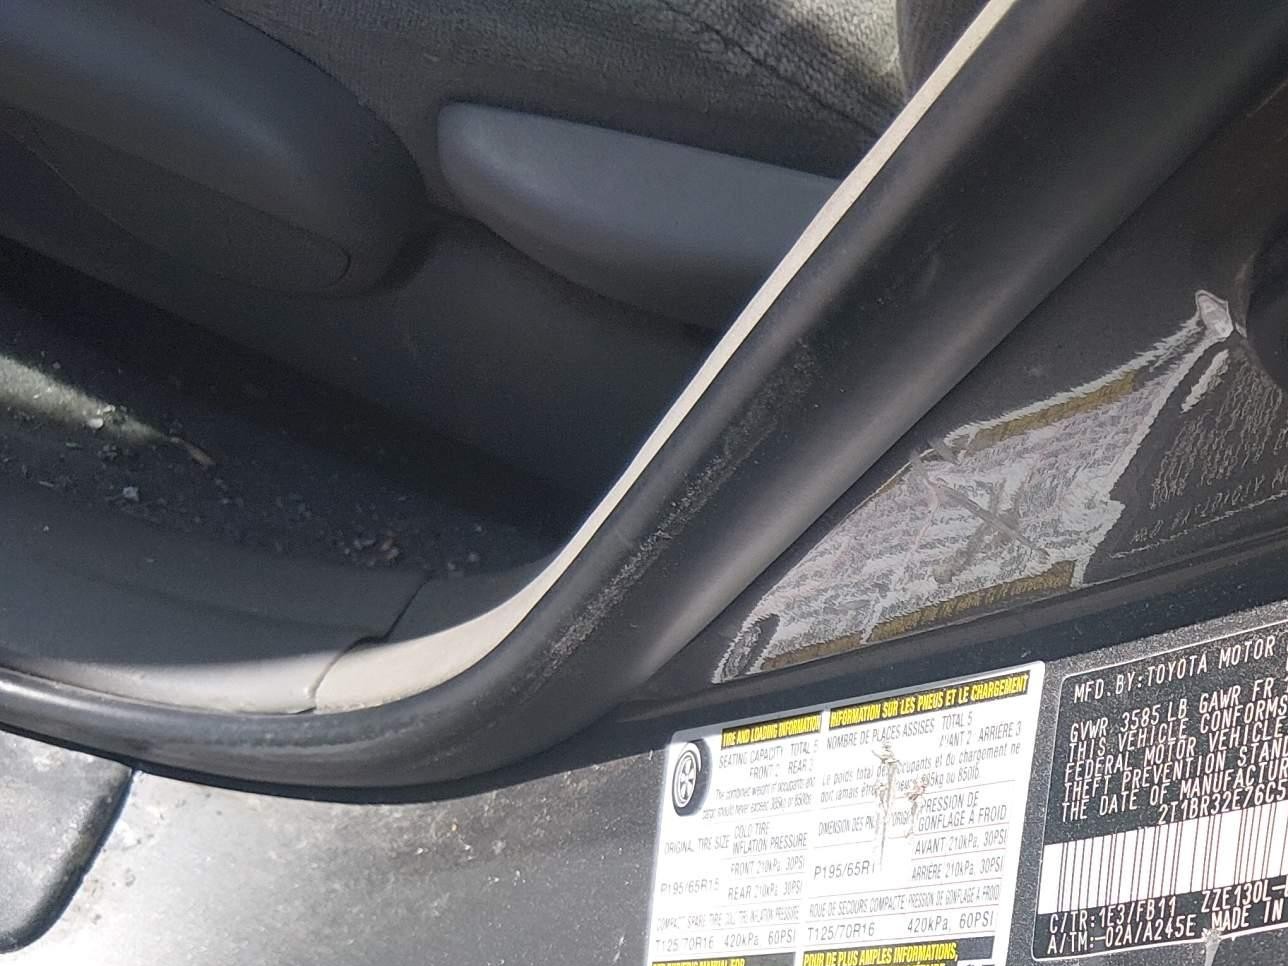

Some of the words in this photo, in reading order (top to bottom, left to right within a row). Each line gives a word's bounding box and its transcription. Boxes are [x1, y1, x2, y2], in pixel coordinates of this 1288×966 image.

[1217, 633, 1277, 671] MOTOR
[829, 701, 881, 729] INFORMATION
[881, 698, 899, 719] SUR
[916, 689, 944, 712] PNEUS
[944, 687, 957, 706] ET
[957, 685, 969, 704] LE
[969, 673, 1029, 703] CHARGEMENT
[1068, 714, 1109, 745] GVWR
[1198, 683, 1241, 715] GAWR
[1251, 675, 1275, 702] FR
[901, 716, 936, 739] ASSISES
[940, 710, 966, 731] TOTAL
[1066, 735, 1107, 764] THIS
[1116, 716, 1190, 754] VEHICLE
[1198, 692, 1288, 735] CONFORMS
[1063, 748, 1134, 786] FEDERAL
[1142, 736, 1197, 768] MOTOR
[1206, 714, 1286, 754] VEHICLE
[1061, 773, 1111, 805] THEFT
[1120, 748, 1227, 793] PREVENTION
[965, 789, 980, 808] DE
[1060, 797, 1089, 824] THE
[1098, 787, 1140, 817] DATE
[1148, 782, 1169, 806] OF
[917, 809, 966, 832] GONFLAGE
[976, 803, 1008, 824] FROID
[913, 836, 946, 855] AVANT
[957, 909, 995, 929] 60PSI
[1209, 905, 1251, 933] MADE
[1262, 897, 1284, 924] IN
[836, 949, 859, 966] PLUS
[858, 946, 893, 966] AMPLES
